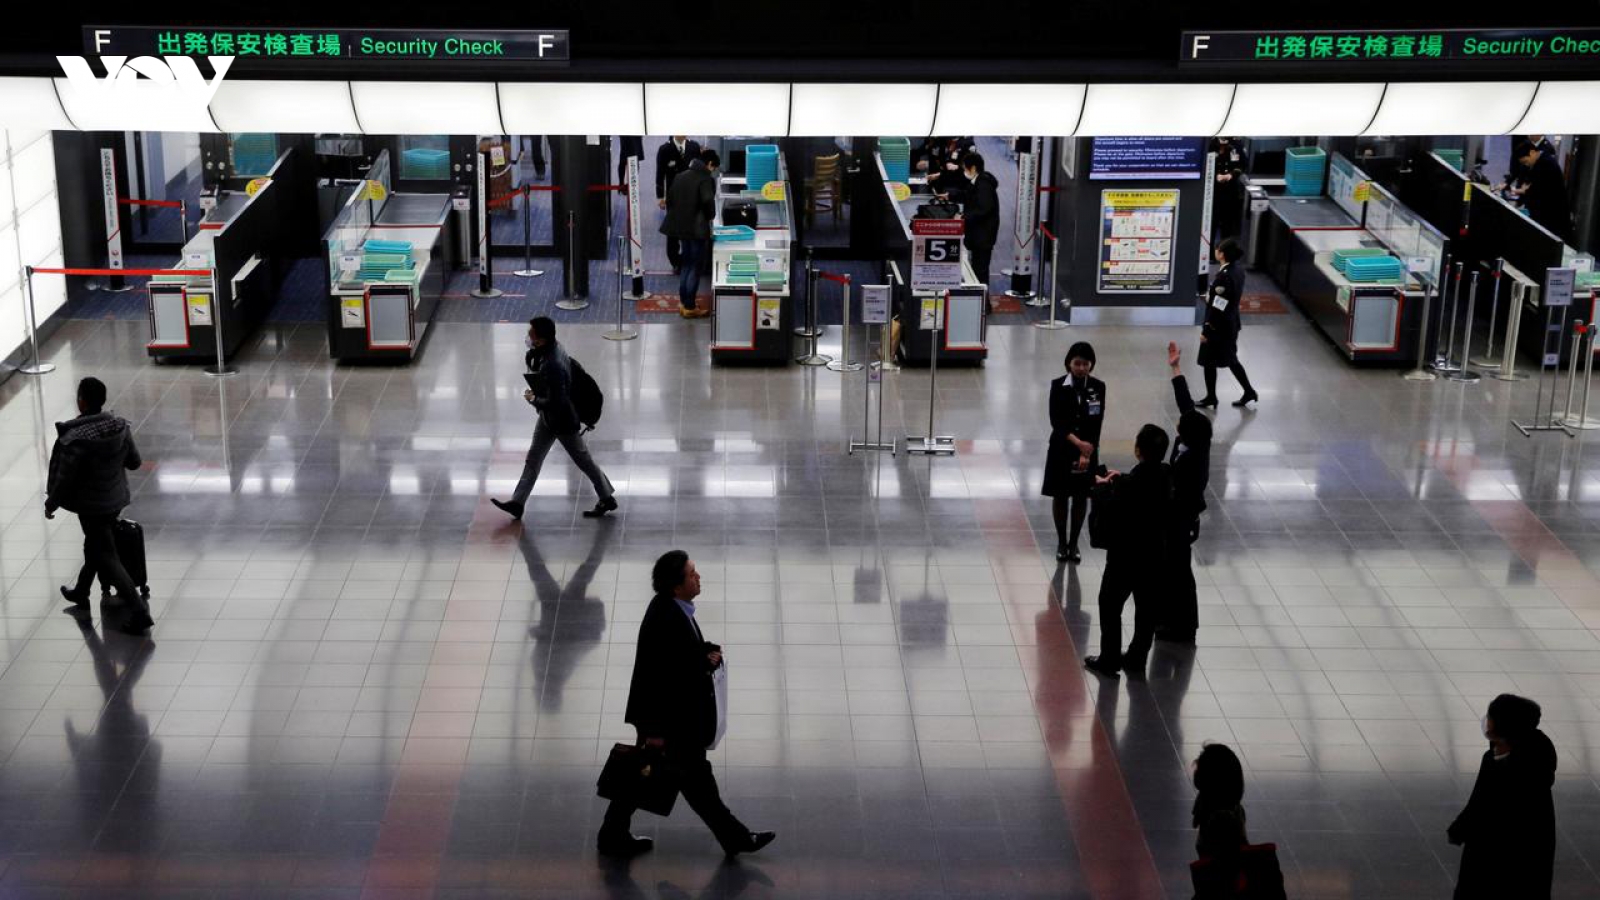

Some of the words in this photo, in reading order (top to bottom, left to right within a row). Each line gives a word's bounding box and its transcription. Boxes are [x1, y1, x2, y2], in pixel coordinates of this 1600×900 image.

[94, 30, 111, 53] F
[159, 32, 341, 56] 出発保安検査場
[360, 37, 438, 58] Security
[444, 38, 503, 55] Check
[538, 34, 555, 57] F
[1192, 36, 1211, 59] F
[1255, 34, 1443, 58] 出発保安検査場
[1463, 37, 1544, 57] Security
[1550, 36, 1600, 54] Chec
[929, 240, 947, 261] 5
